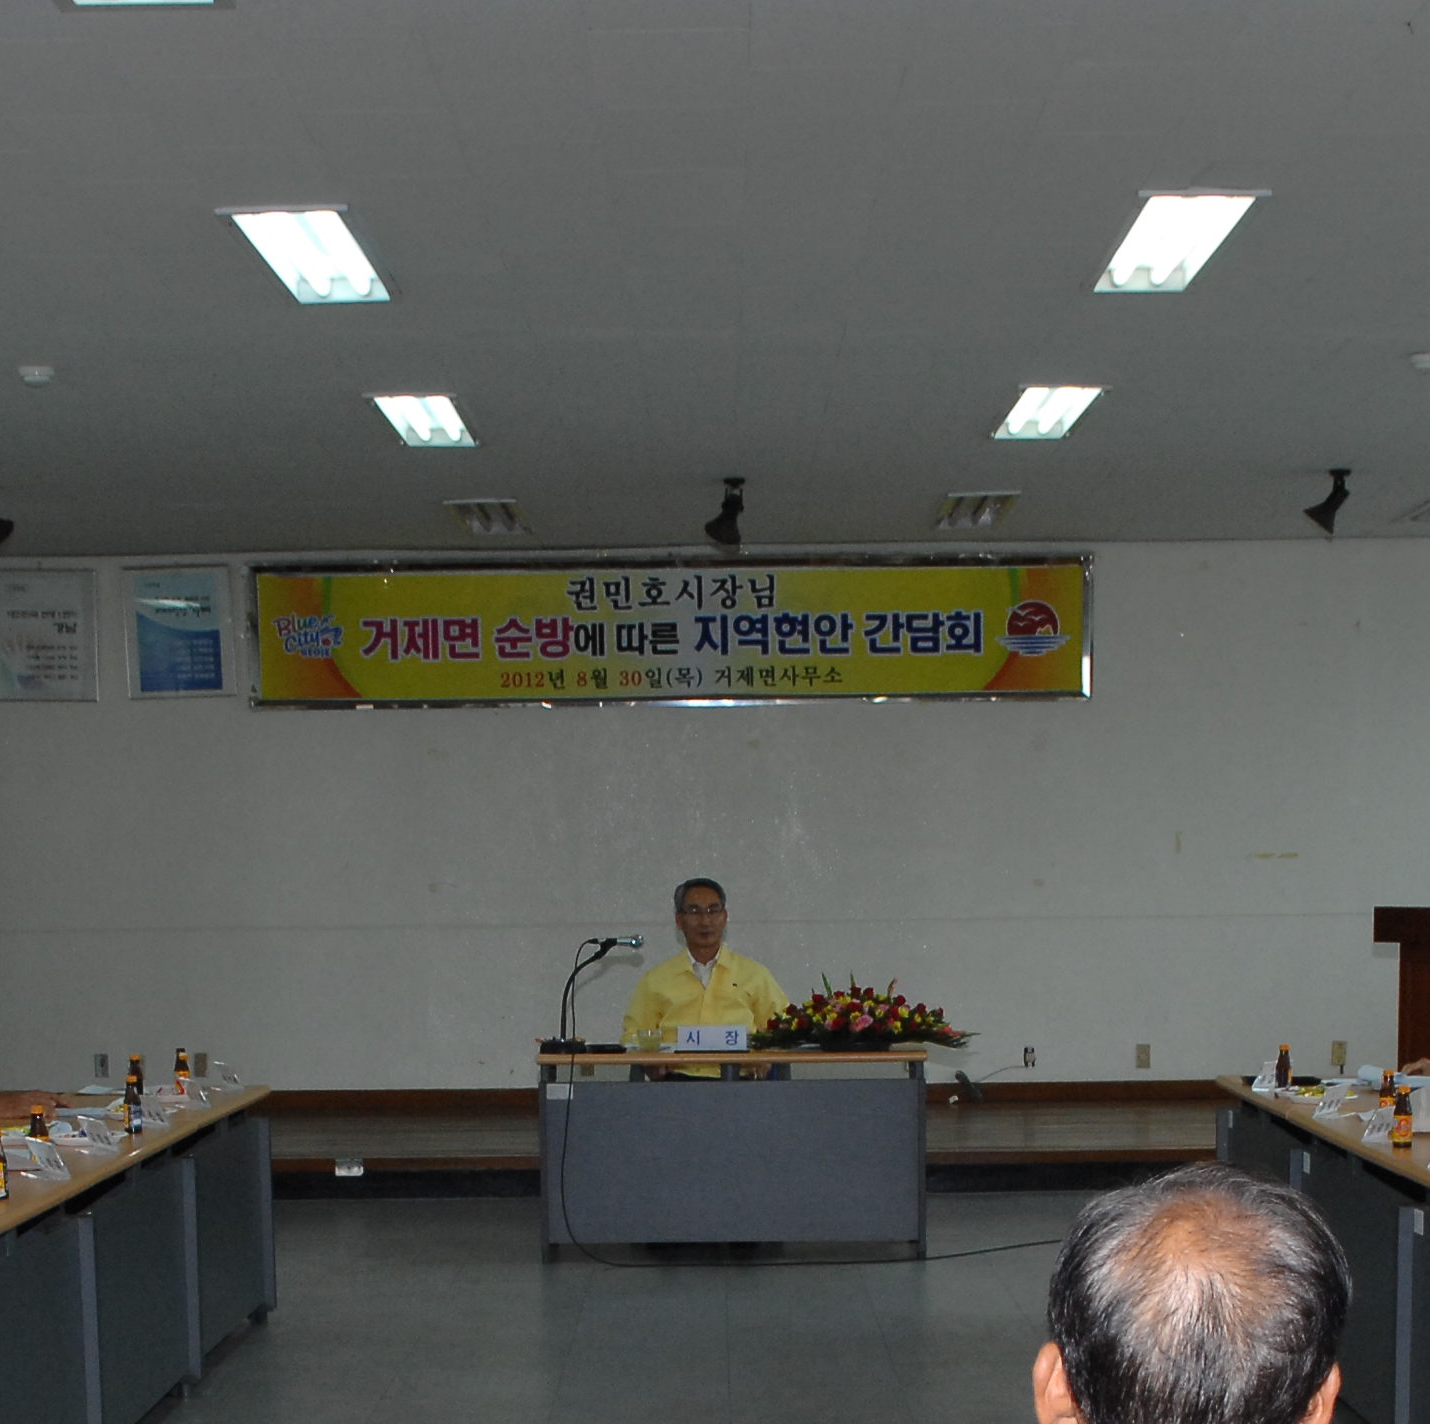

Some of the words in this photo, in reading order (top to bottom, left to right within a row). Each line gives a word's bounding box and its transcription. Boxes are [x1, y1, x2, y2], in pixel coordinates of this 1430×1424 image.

[567, 575, 775, 611] 권민호시장님
[273, 614, 317, 637] Blue
[361, 616, 481, 662] 거제면
[493, 615, 605, 660] 순방에
[615, 620, 680, 657] 따른
[693, 611, 852, 657] 지역현안
[862, 609, 984, 656] 간담회
[284, 631, 320, 653] City
[500, 669, 566, 690] 2012년
[576, 668, 608, 690] 8월
[619, 666, 703, 690] 30일(목)
[714, 664, 844, 688] 거제면사무소
